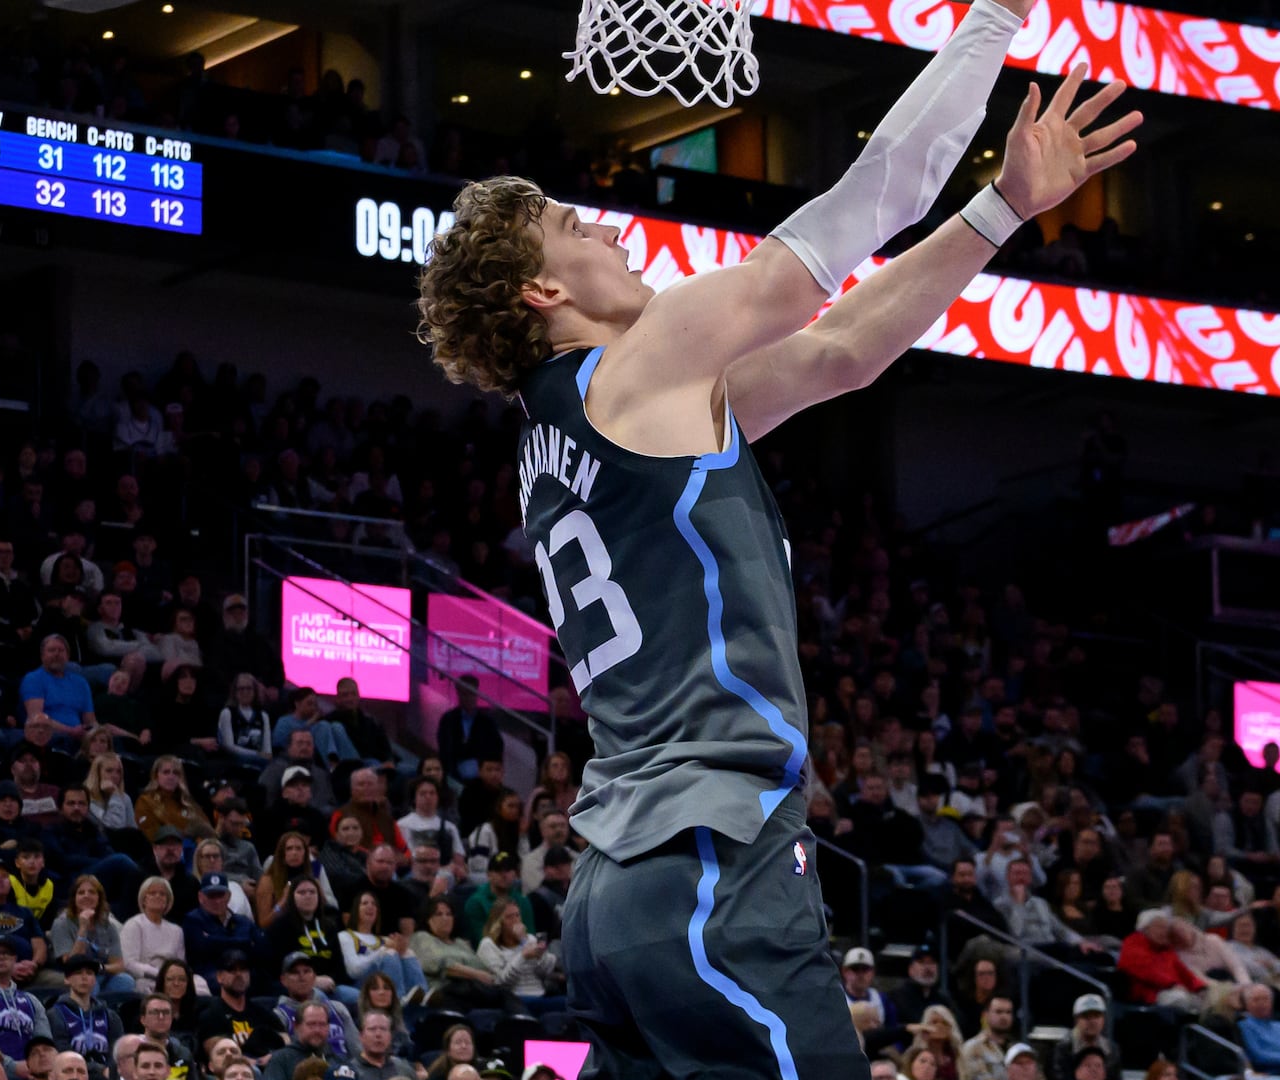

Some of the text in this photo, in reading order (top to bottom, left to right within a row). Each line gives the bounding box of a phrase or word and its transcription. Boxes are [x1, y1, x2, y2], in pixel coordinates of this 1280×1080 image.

[26, 116, 78, 143] BENCH
[87, 126, 134, 152] O-RTG
[38, 143, 63, 171] 31
[145, 135, 192, 162] D-RTG
[92, 152, 127, 181] 112
[150, 162, 185, 190] 113
[35, 179, 66, 208] 32
[91, 188, 127, 217] 113
[150, 197, 184, 227] 112
[301, 612, 331, 627] JUST
